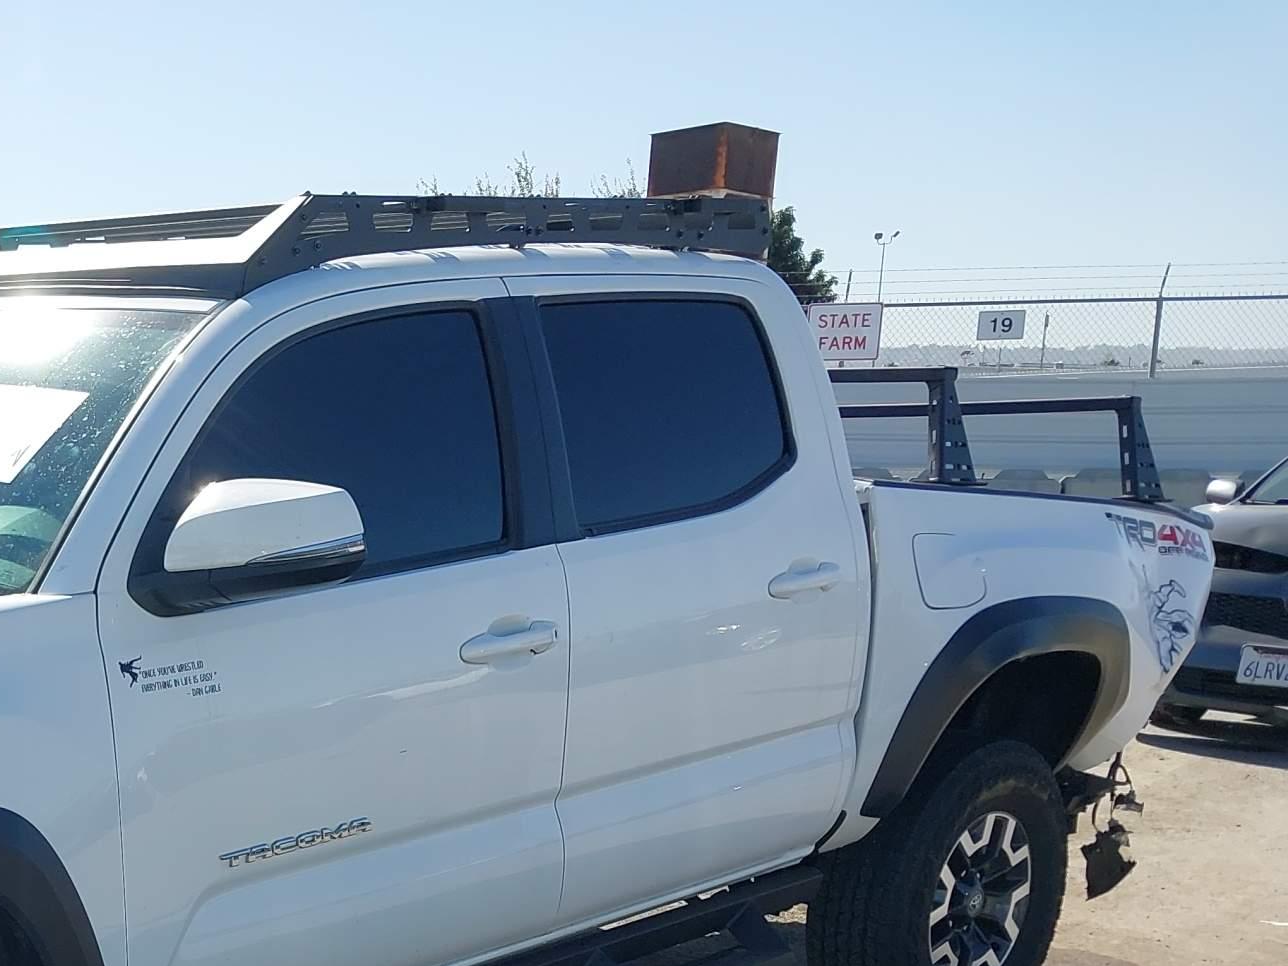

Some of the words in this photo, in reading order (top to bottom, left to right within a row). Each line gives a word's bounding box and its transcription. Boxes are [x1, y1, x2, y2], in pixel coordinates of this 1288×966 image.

[818, 313, 872, 329] STATE
[990, 317, 1013, 333] 19
[818, 336, 867, 351] FARM
[1104, 511, 1156, 551] TRD
[219, 816, 372, 867] TACOMA
